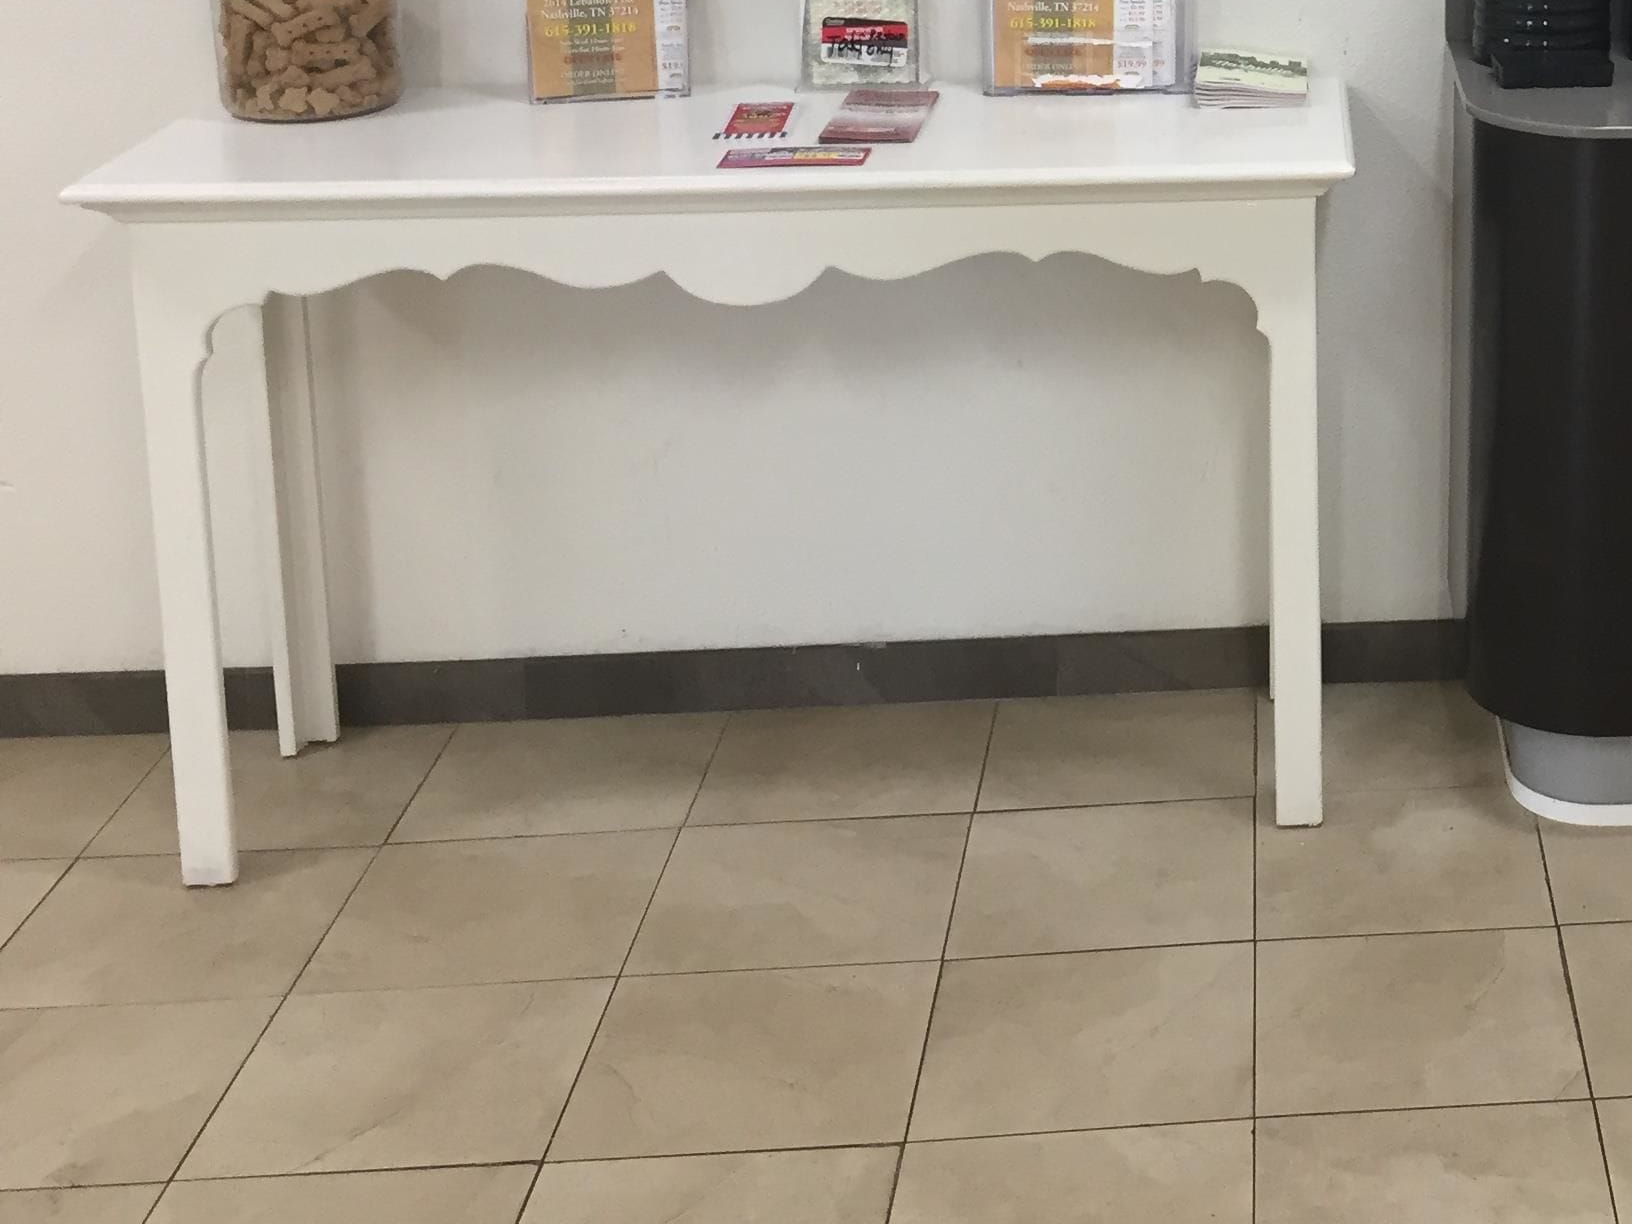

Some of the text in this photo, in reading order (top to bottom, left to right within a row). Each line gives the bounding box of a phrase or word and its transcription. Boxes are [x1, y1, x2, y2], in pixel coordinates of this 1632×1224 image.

[590, 7, 606, 17] TN
[1054, 2, 1070, 12] TN
[1010, 17, 1096, 28] 615-391-1818
